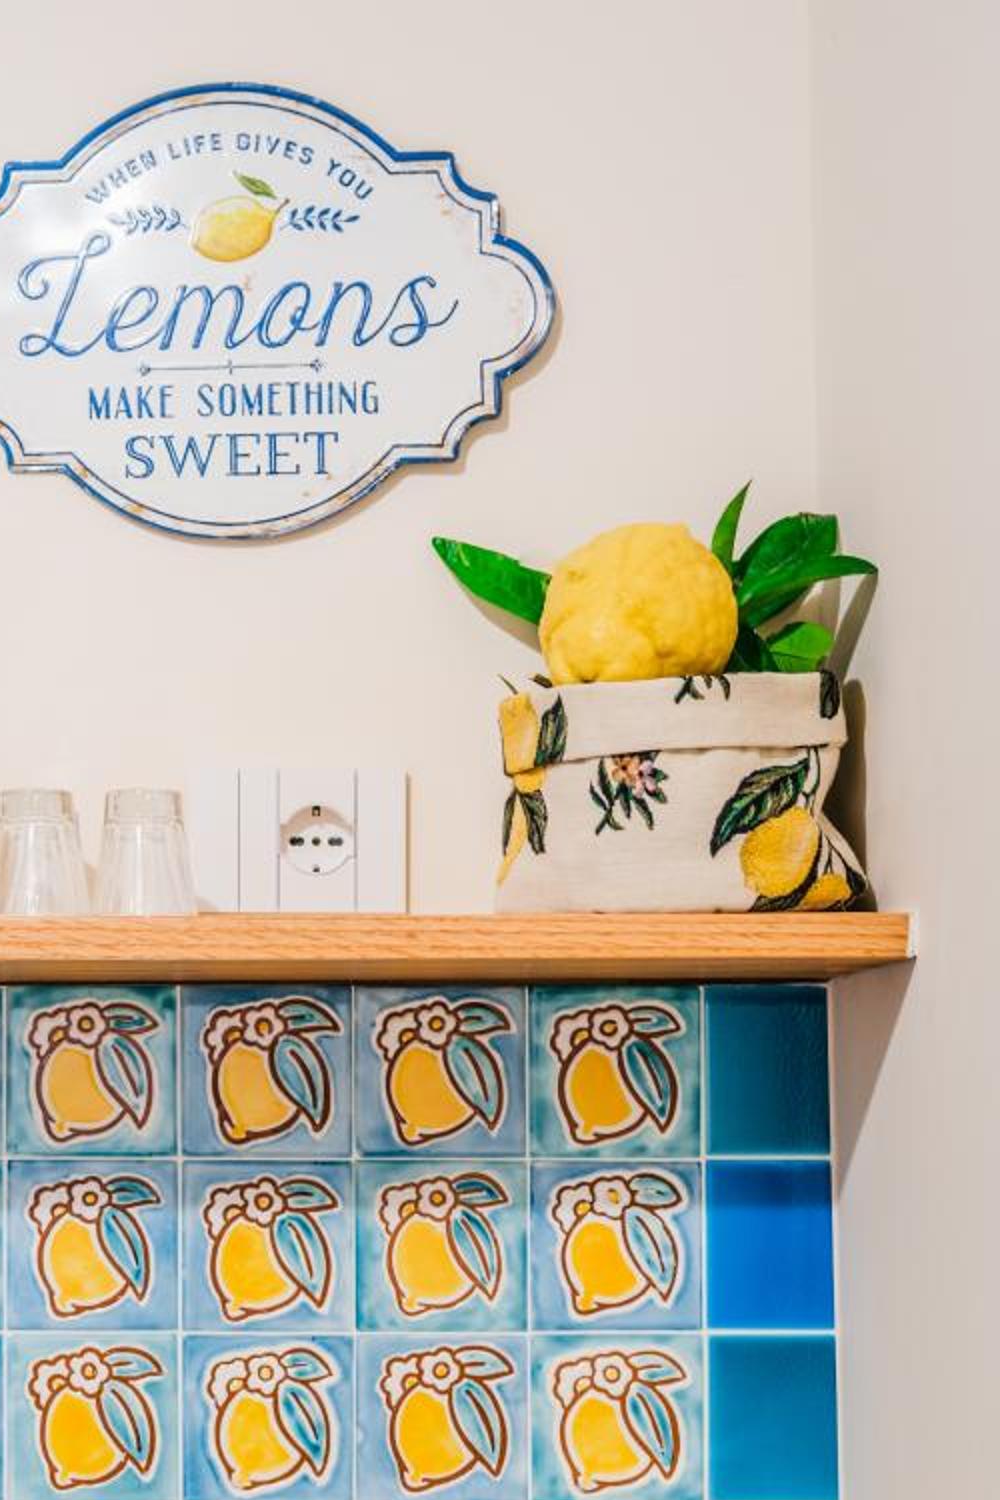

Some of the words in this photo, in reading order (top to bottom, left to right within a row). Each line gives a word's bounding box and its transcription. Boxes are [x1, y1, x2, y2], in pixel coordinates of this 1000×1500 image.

[85, 149, 159, 204] WHEN
[167, 133, 223, 160] LIFE
[237, 132, 316, 165] GIVES
[326, 158, 375, 201] YOU
[17, 233, 458, 357] Lemons
[88, 384, 175, 420] MAKE
[197, 381, 380, 417] SOMETHING
[125, 431, 339, 479] SWEET
